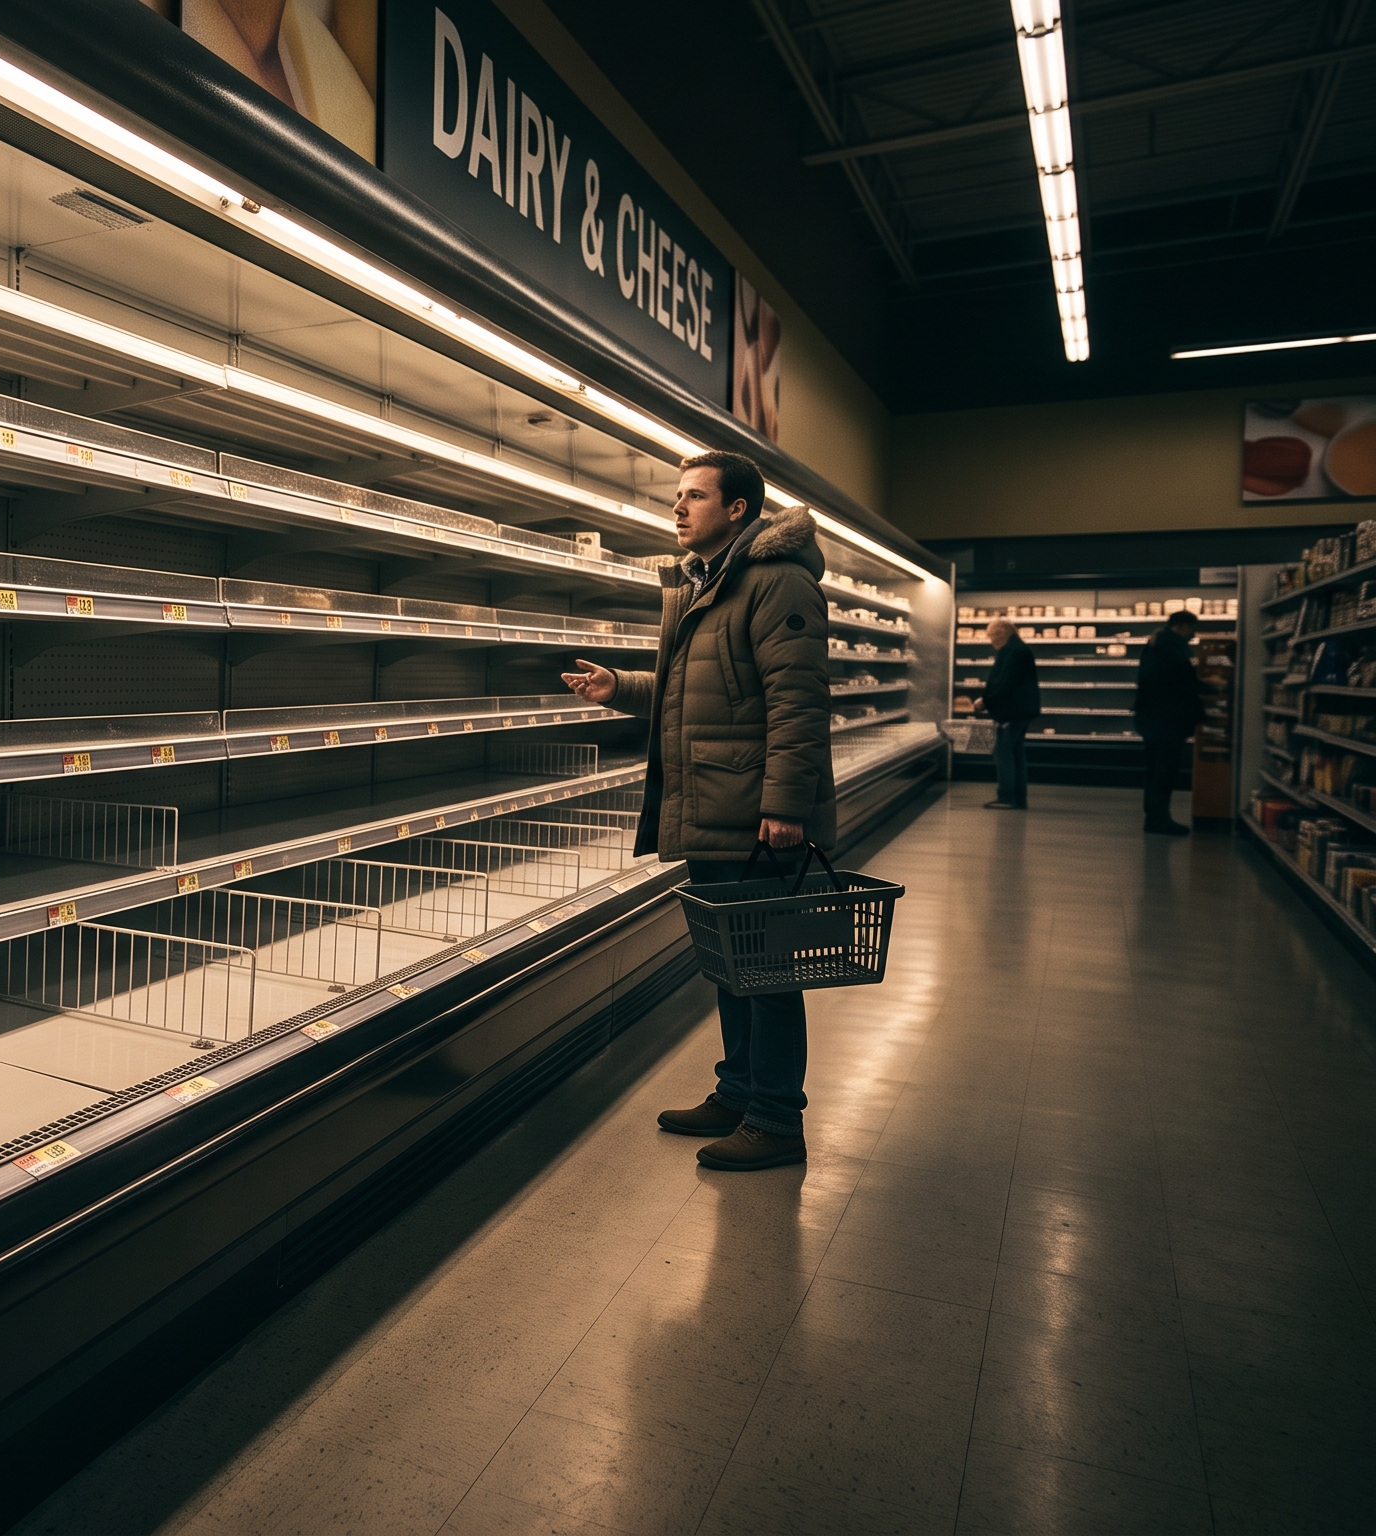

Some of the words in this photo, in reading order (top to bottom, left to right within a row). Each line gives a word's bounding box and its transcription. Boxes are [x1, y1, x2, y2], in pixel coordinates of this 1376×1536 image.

[433, 6, 571, 244] DAIRY
[581, 158, 604, 278] &
[616, 193, 713, 362] CHEESE
